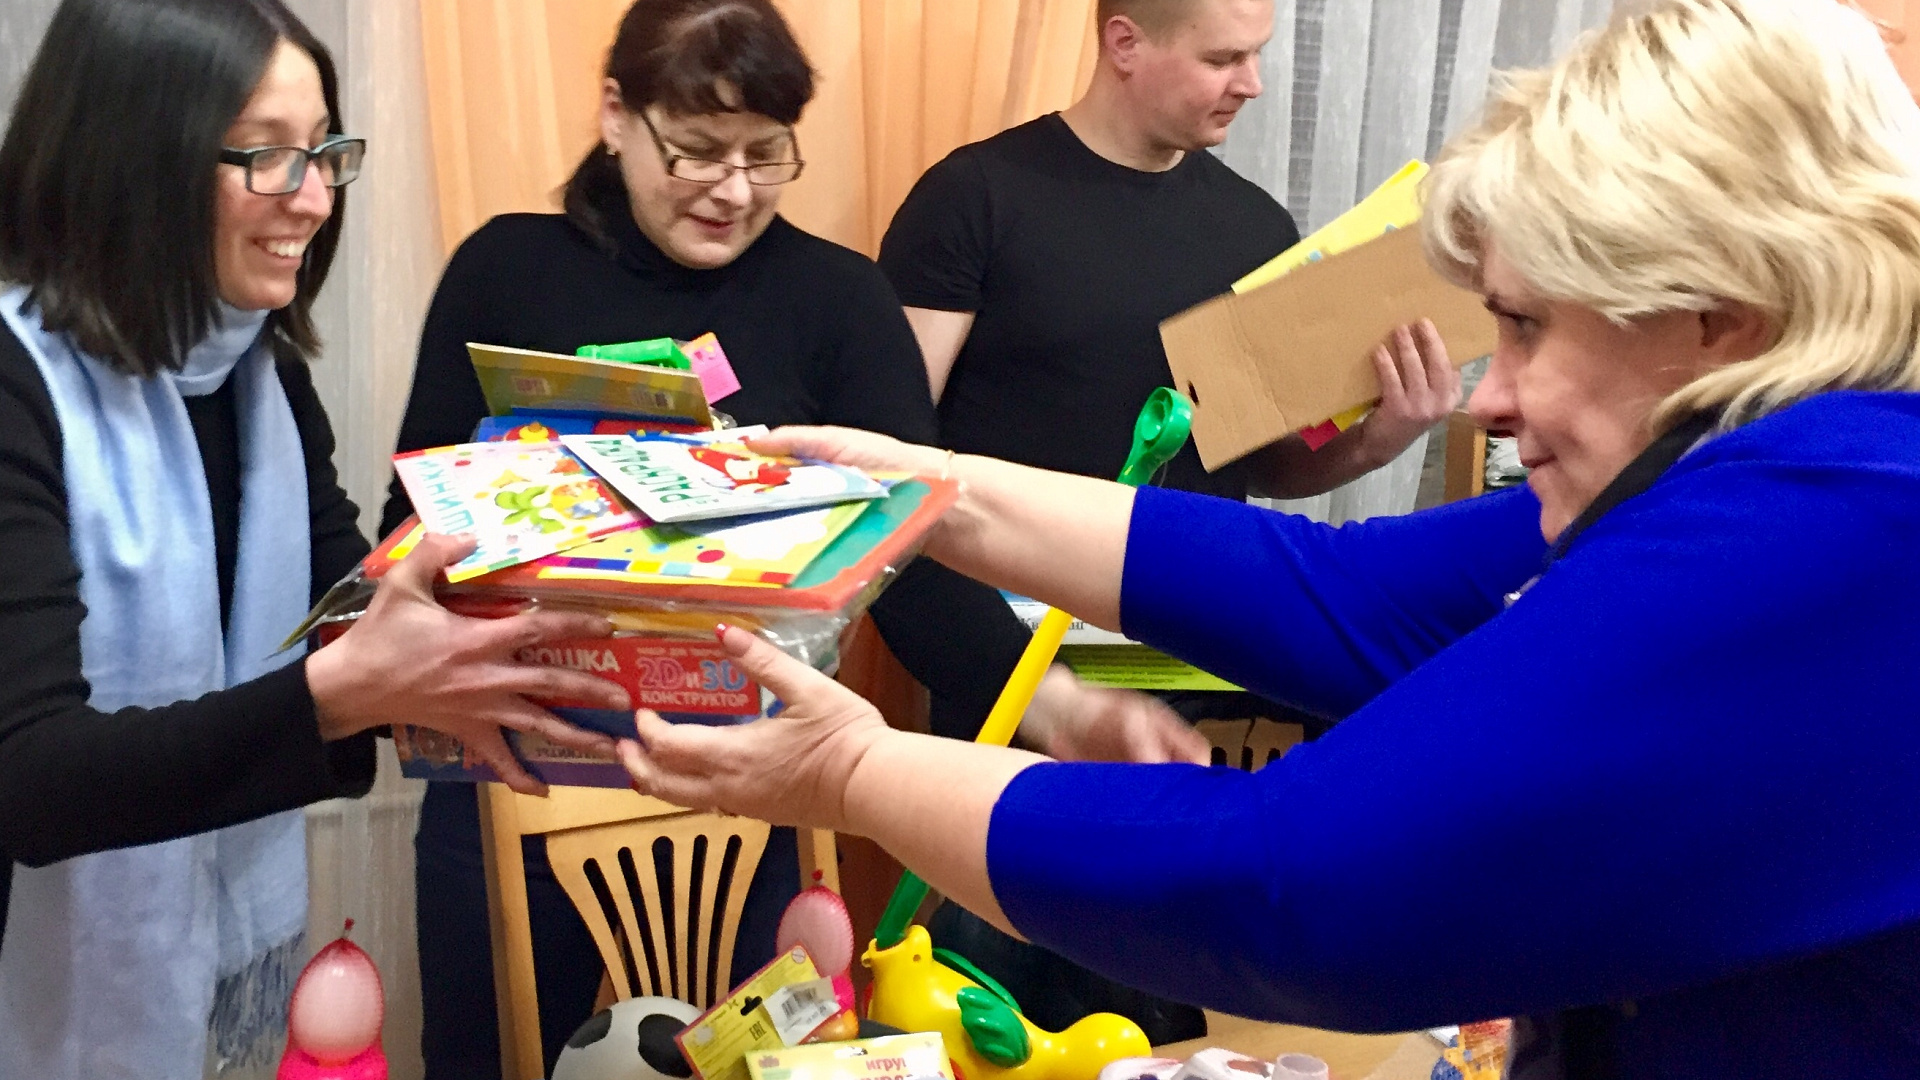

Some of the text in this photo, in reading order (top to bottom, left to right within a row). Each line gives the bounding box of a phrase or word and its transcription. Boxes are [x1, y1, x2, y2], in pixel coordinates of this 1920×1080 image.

[416, 460, 487, 565] ШИНКИ
[636, 656, 686, 690] 2D
[700, 659, 748, 691] 3D
[640, 690, 749, 708] КОНСТРУКТОР
[865, 1057, 907, 1072] игру
